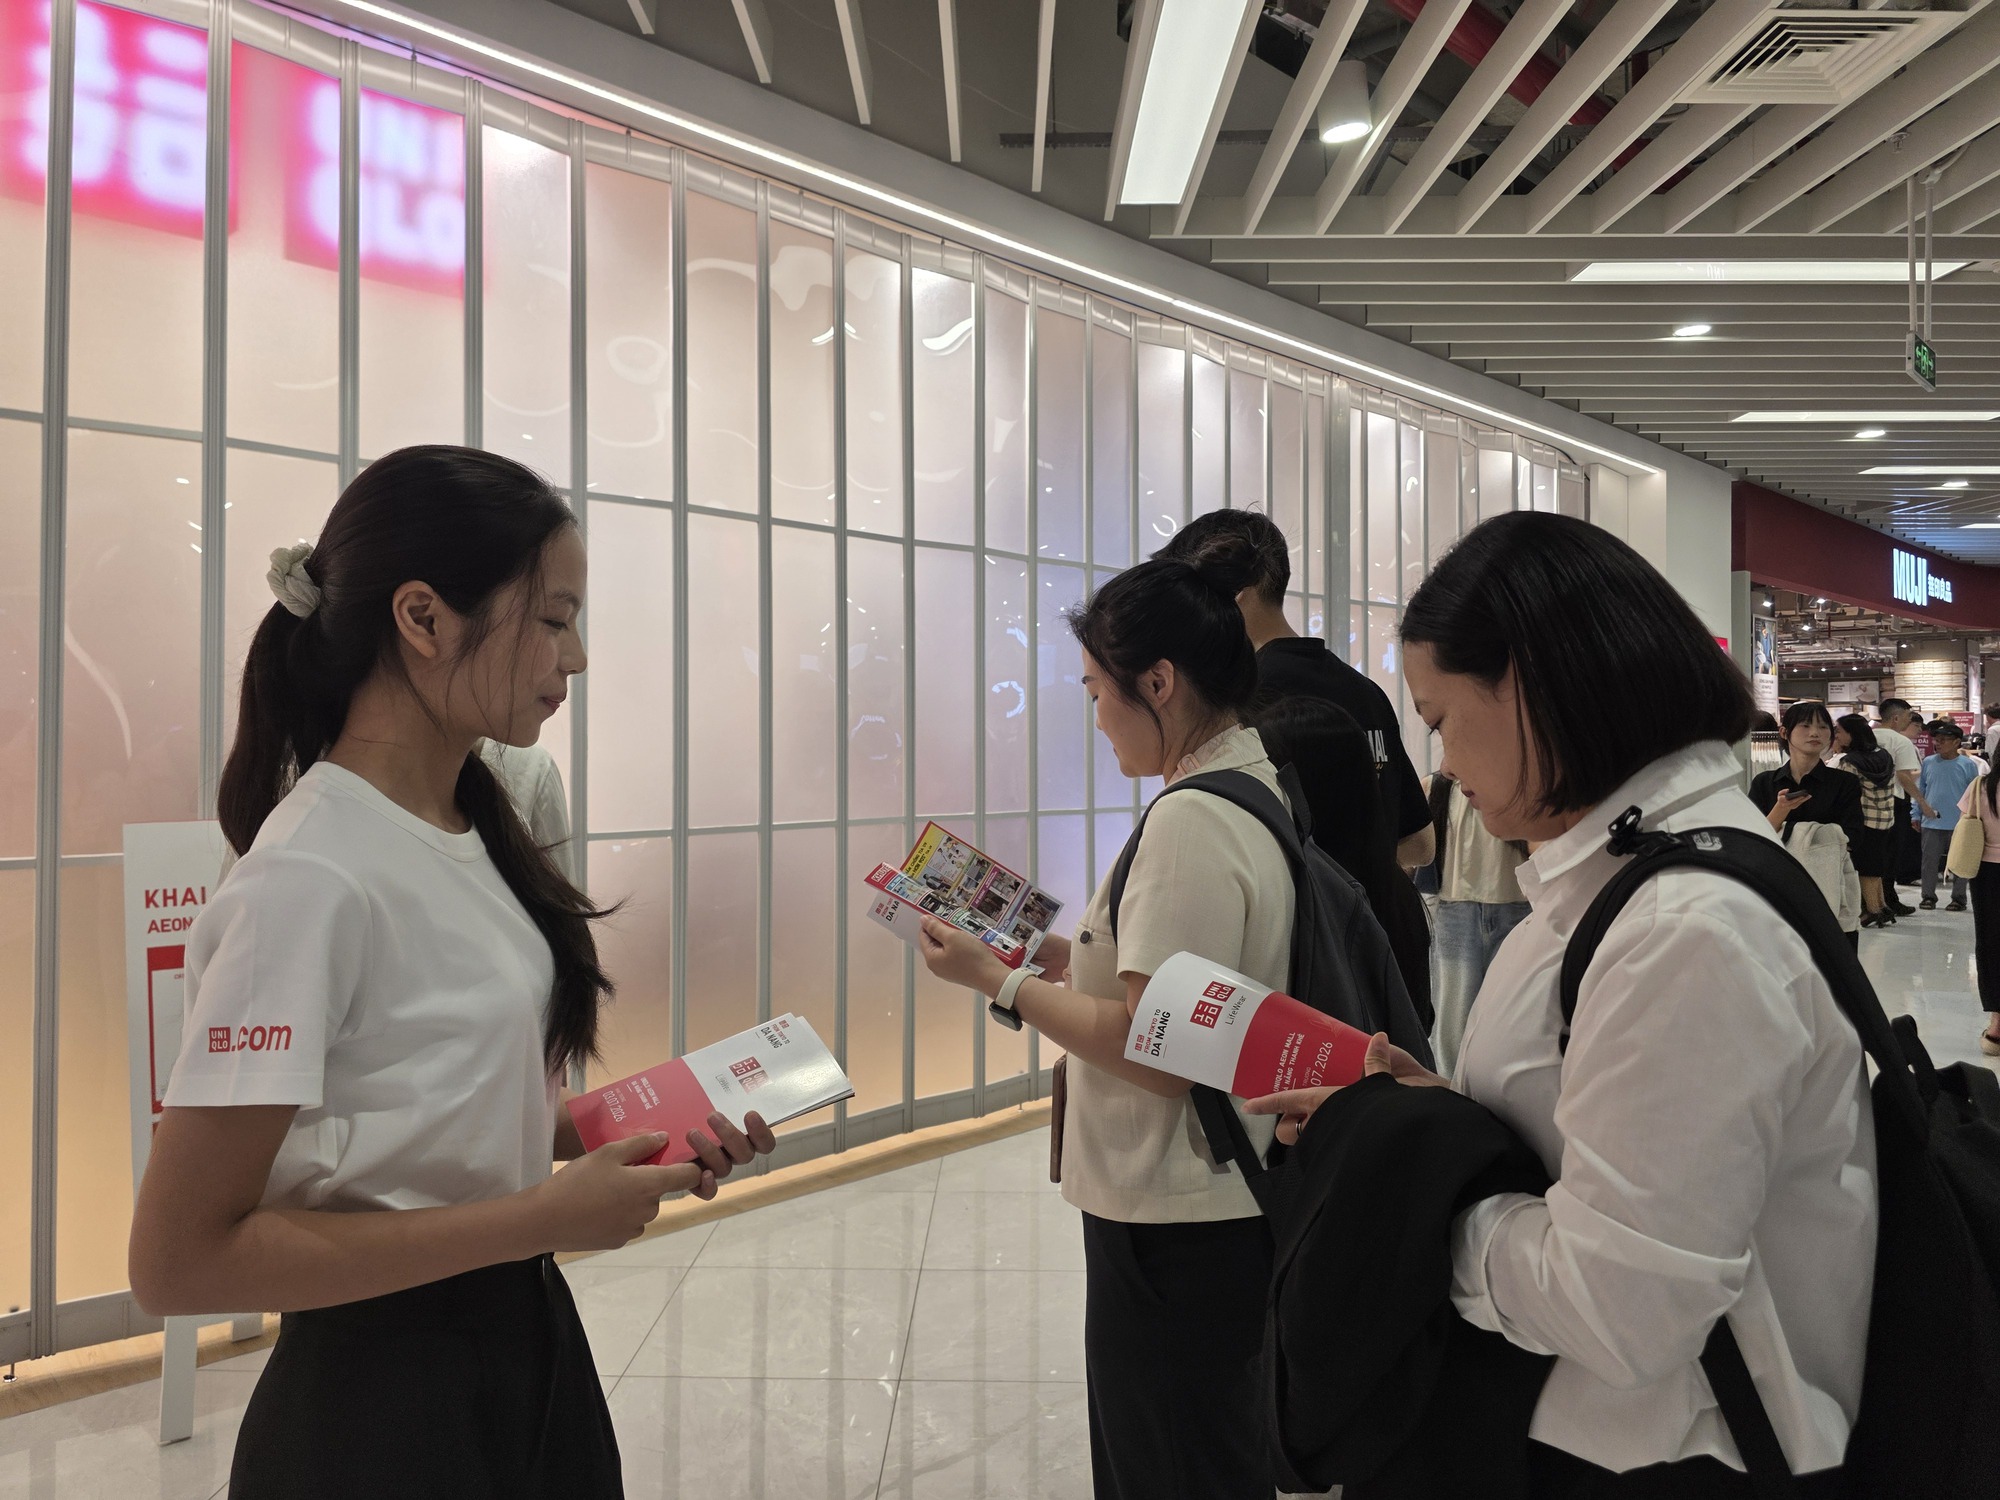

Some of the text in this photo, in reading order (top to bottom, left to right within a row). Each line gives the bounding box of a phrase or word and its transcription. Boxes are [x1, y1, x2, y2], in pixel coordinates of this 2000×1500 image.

[1893, 548, 1927, 606] MUJI
[145, 886, 206, 909] KHAI
[885, 900, 900, 922] DA NA
[147, 916, 195, 934] AEON
[1206, 983, 1222, 997] UNI
[1216, 986, 1232, 999] QLO
[1225, 995, 1247, 1025] LifeWear
[211, 1030, 227, 1039] UNI
[231, 1025, 292, 1051] .com
[761, 1027, 782, 1048] DA NANG
[1144, 1008, 1161, 1054] FROM TOKYO TO
[1151, 1011, 1171, 1057] DA NANG
[211, 1040, 228, 1051] QLO
[1289, 1046, 1300, 1065] THANH
[1273, 1032, 1296, 1092] UNIQLO AEON MALL
[1310, 1041, 1333, 1087] 07.2026
